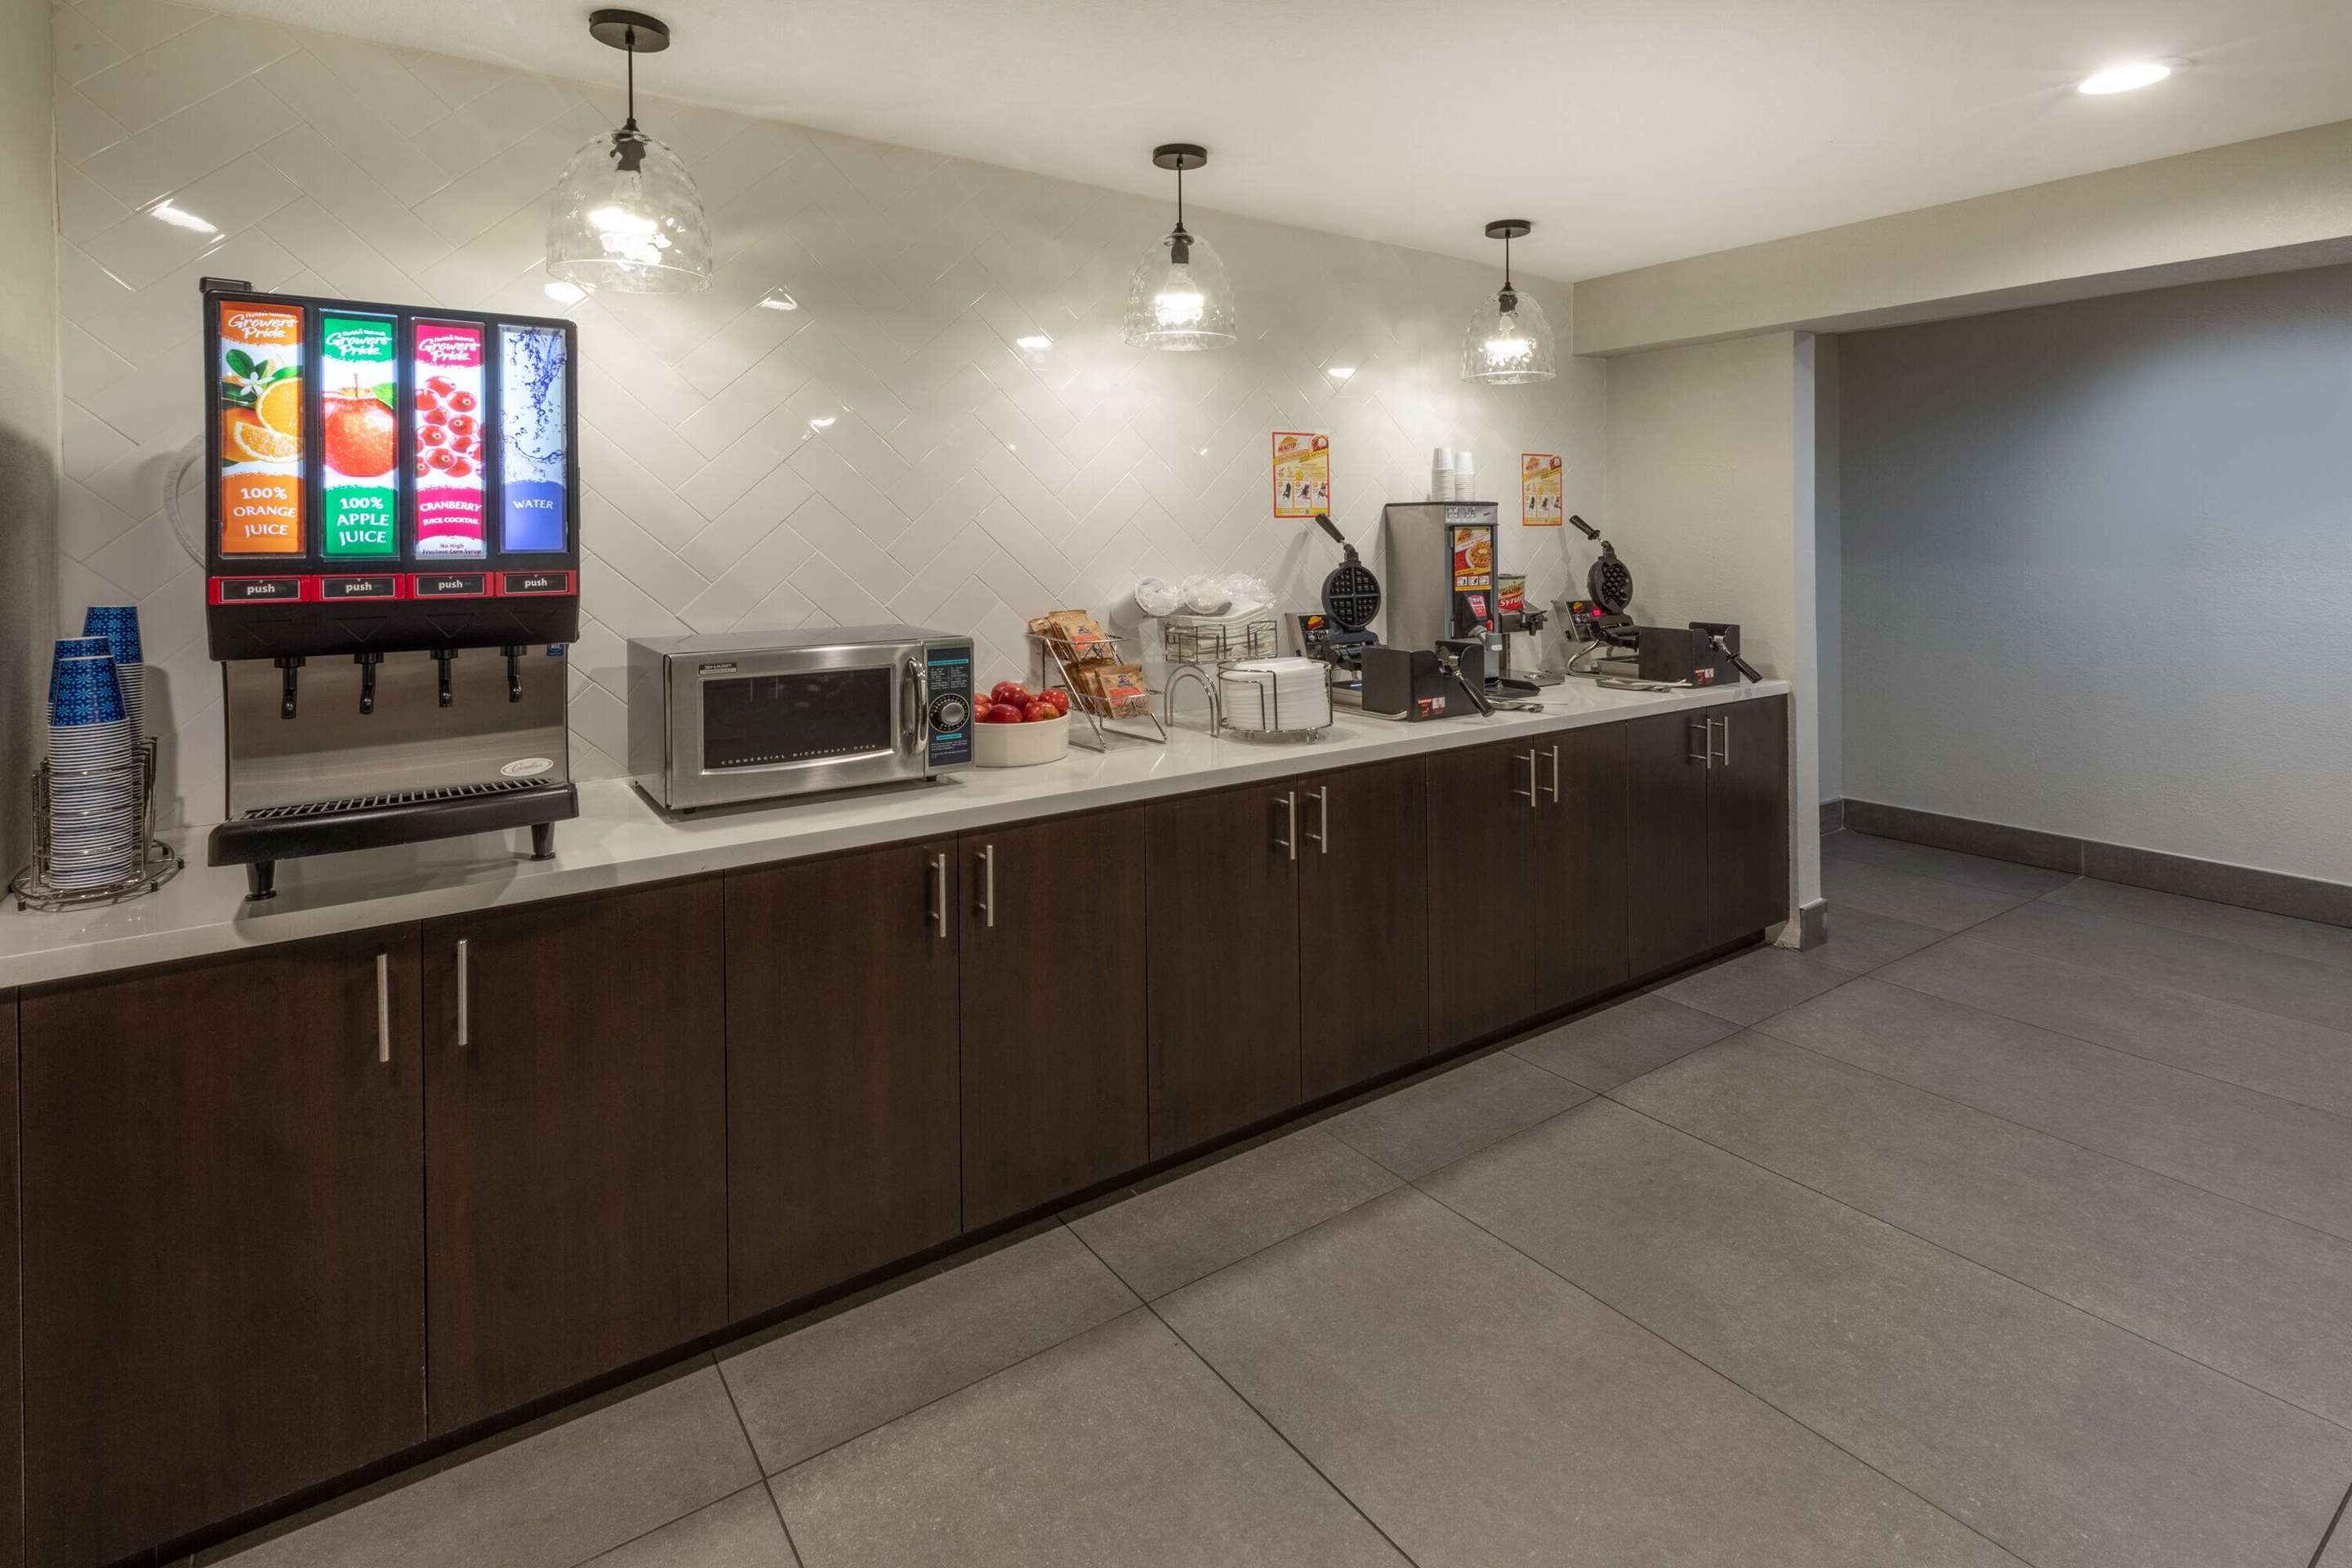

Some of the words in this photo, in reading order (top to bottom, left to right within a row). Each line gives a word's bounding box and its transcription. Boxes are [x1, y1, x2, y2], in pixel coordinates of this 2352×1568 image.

[228, 314, 299, 328] Growers
[326, 332, 392, 346] Growers
[418, 338, 481, 352] Growers
[240, 487, 287, 500] 100%
[340, 497, 384, 510] 100%
[419, 501, 482, 512] CRANBERRY
[513, 499, 555, 510] WATER
[233, 505, 296, 518] ORANGE
[336, 513, 390, 527] APPLE
[423, 517, 443, 526] JUICE
[443, 516, 479, 524] COCKTAIL
[244, 523, 288, 538] JUICE
[339, 530, 387, 546] JUICE
[450, 542, 465, 550] High
[247, 583, 275, 595] push
[345, 582, 372, 593] push
[438, 579, 463, 591] push
[524, 577, 548, 589] push
[792, 746, 847, 757] MICROWAVE
